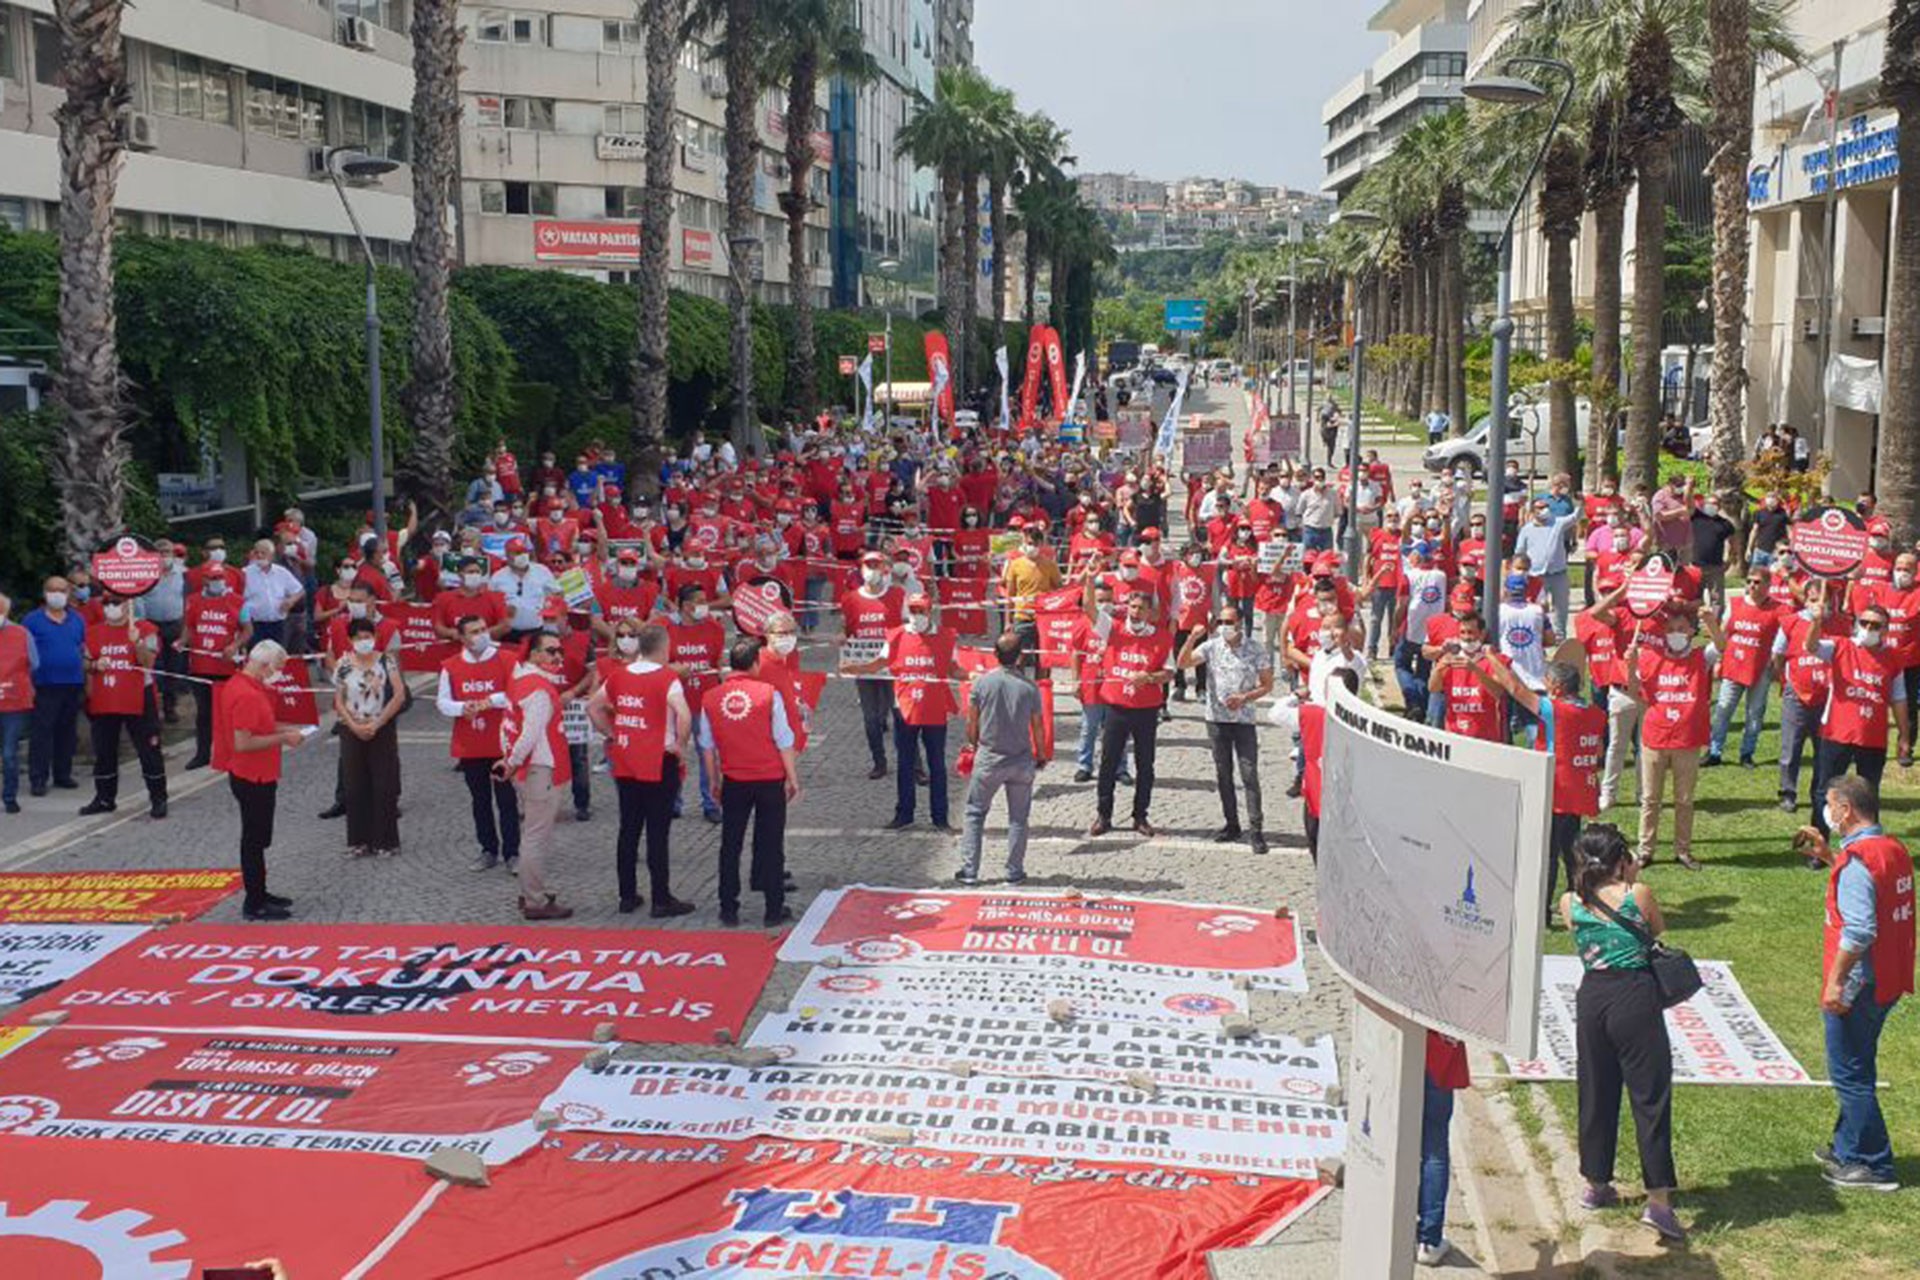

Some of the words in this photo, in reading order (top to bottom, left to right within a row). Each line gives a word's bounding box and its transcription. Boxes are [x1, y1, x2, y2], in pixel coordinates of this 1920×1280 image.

[562, 231, 598, 245] VATAN
[905, 655, 935, 667] DİSK
[462, 680, 495, 693] DİSK
[139, 944, 320, 960] KIDEM
[337, 943, 727, 967] TAZMİNATIMA
[1091, 936, 1130, 957] OL
[187, 965, 646, 993] DOKUNMA
[923, 952, 1028, 967] GENEL
[1107, 963, 1196, 979] NOLU
[60, 988, 186, 1006] DİSK
[470, 998, 714, 1022] METAL-İŞ
[174, 1056, 299, 1077] TOPLUMSAL
[303, 1060, 380, 1079] DÜZEN
[880, 1040, 1212, 1074] YETMEYECEK
[1113, 1040, 1319, 1069] ALMAYA
[746, 1068, 968, 1092] TAZMİNATI
[275, 1097, 334, 1124] OL
[764, 1087, 914, 1106] ANCAK
[926, 1094, 1001, 1113] BİR
[1017, 1099, 1333, 1139] MÜCADELENİN
[36, 1121, 112, 1139] DİSK
[112, 1125, 182, 1143] EGE
[182, 1127, 285, 1149] BÖLGE
[774, 1105, 954, 1129] SONUCU
[970, 1115, 1172, 1146] OLABİLİR
[962, 1155, 1211, 1193] Değerdir
